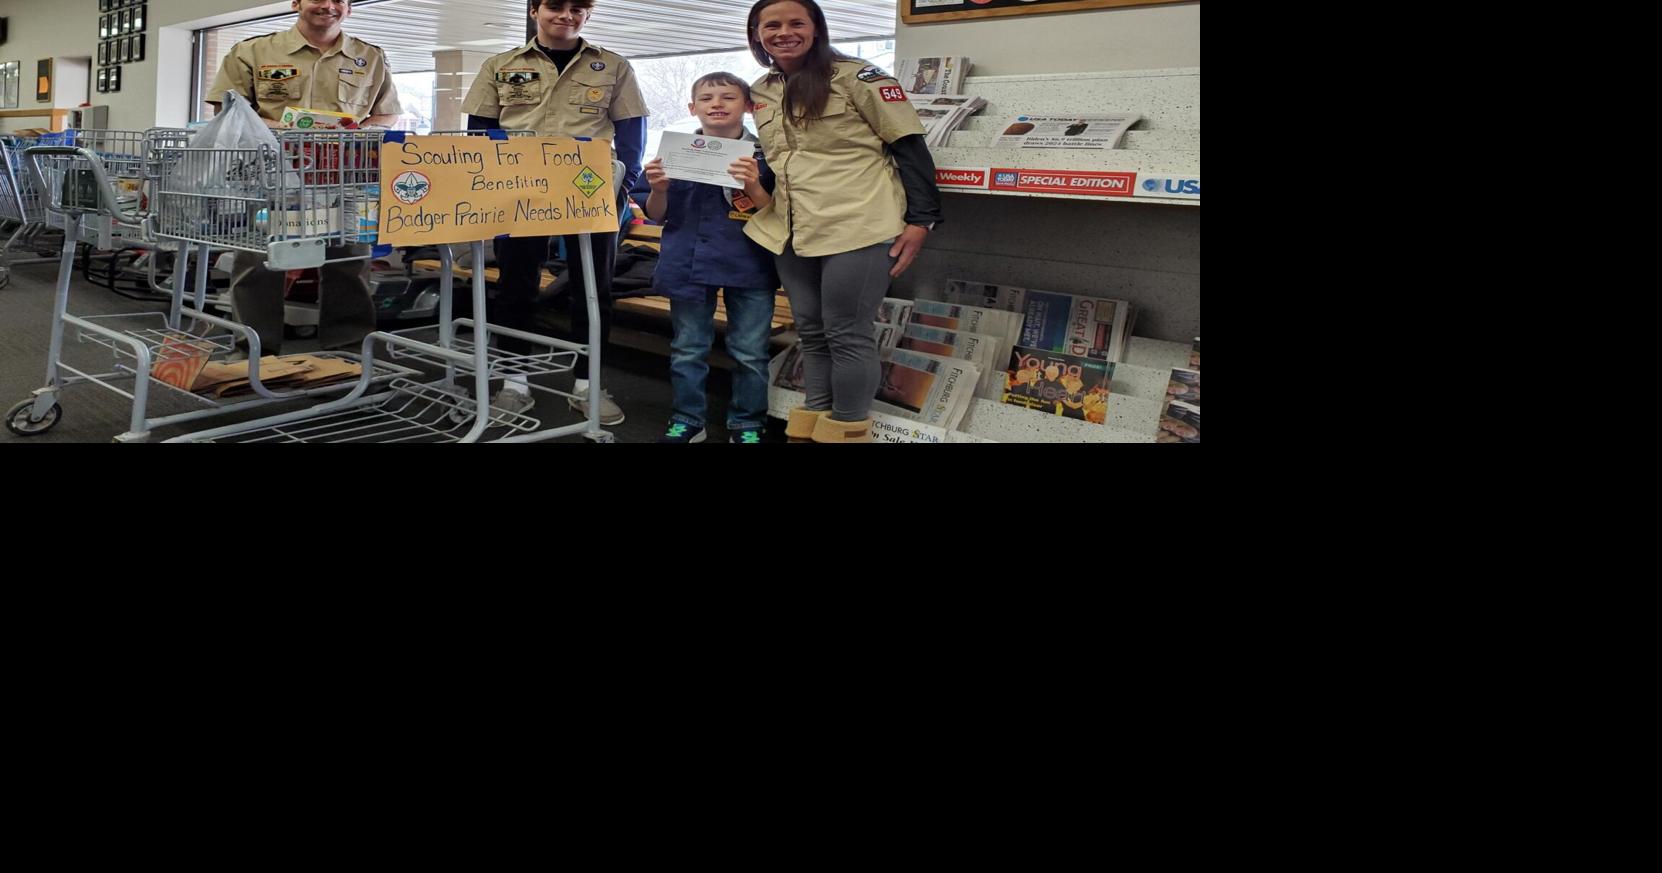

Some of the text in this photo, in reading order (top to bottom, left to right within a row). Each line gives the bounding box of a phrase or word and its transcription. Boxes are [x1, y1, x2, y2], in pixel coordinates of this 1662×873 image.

[882, 88, 902, 99] 549
[400, 142, 583, 174] Scouting For Food
[471, 174, 549, 193] Benefiting
[940, 172, 982, 184] Weekly
[1020, 175, 1067, 187] SPECIAL
[1070, 177, 1125, 189] EDITION
[1164, 179, 1199, 194] US
[386, 195, 614, 234] Badger Prairie Needs Network
[1073, 299, 1095, 337] GREAT
[940, 367, 963, 403] FITCHBURG
[871, 420, 939, 443] TCHBURG STAR
